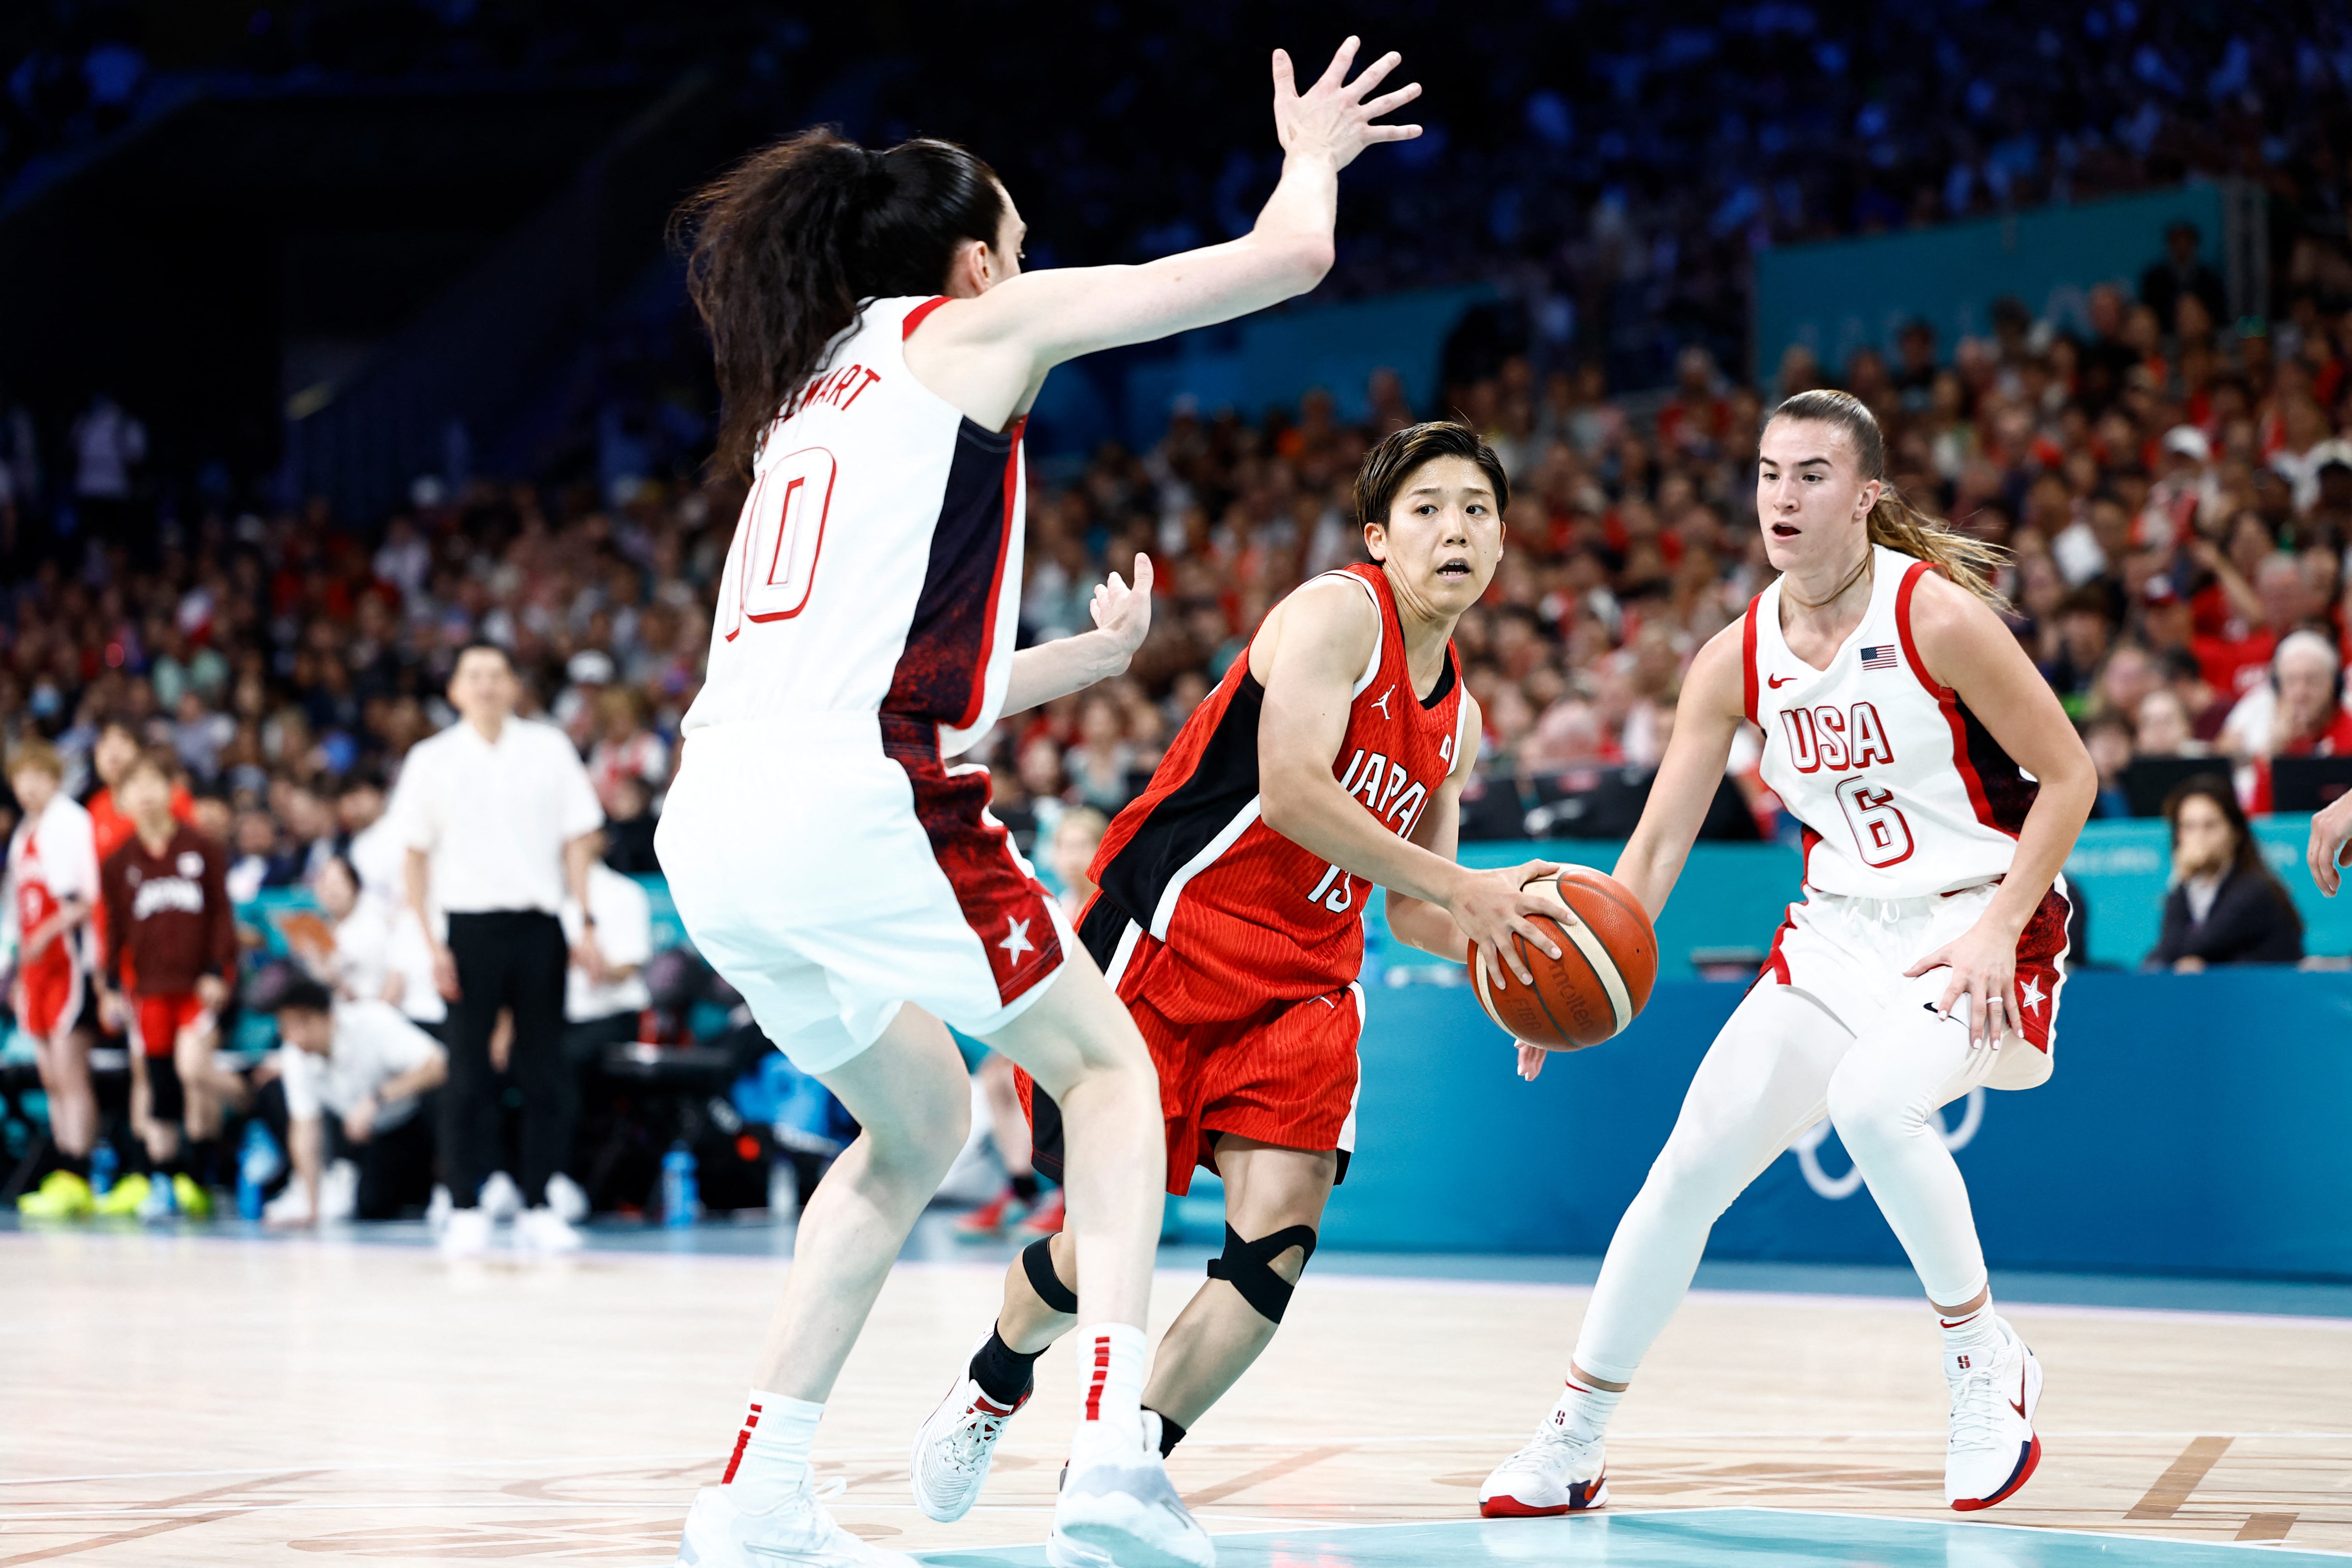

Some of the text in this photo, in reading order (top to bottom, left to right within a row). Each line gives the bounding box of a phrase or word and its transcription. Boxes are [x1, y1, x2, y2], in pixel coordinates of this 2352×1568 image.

[724, 447, 837, 643] 10
[1780, 701, 1894, 773] USA
[1339, 749, 1429, 841] JAPA
[1835, 775, 1915, 868] 6
[1512, 997, 1543, 1031] FIBA
[1548, 961, 1595, 1033] molten
